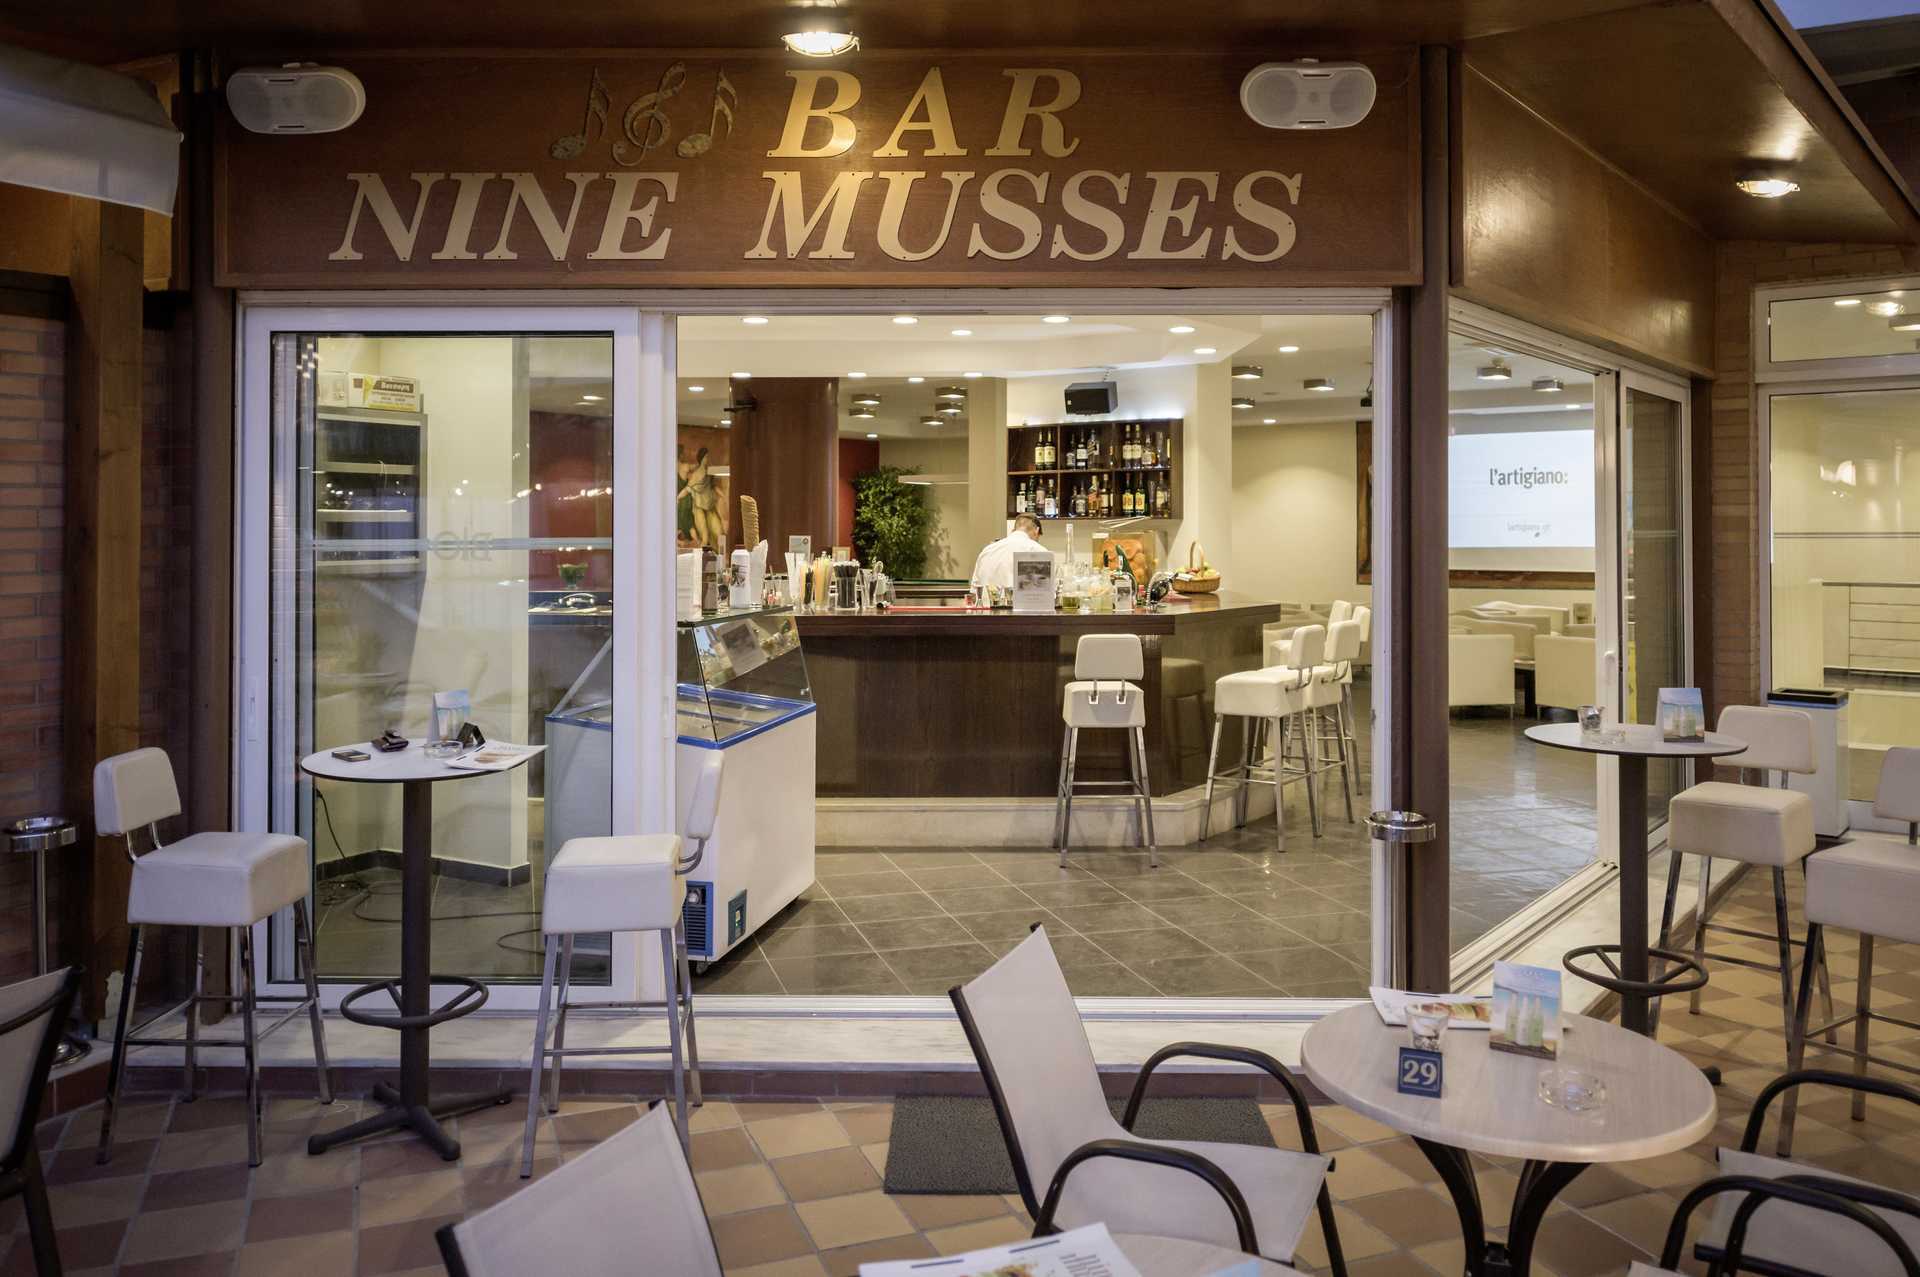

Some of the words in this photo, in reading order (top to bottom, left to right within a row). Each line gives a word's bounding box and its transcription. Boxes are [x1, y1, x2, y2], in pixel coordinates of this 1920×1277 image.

[766, 67, 1082, 158] BAR
[328, 172, 679, 260] NINE
[743, 169, 1303, 262] MUSSES
[1403, 1060, 1437, 1085] 29
